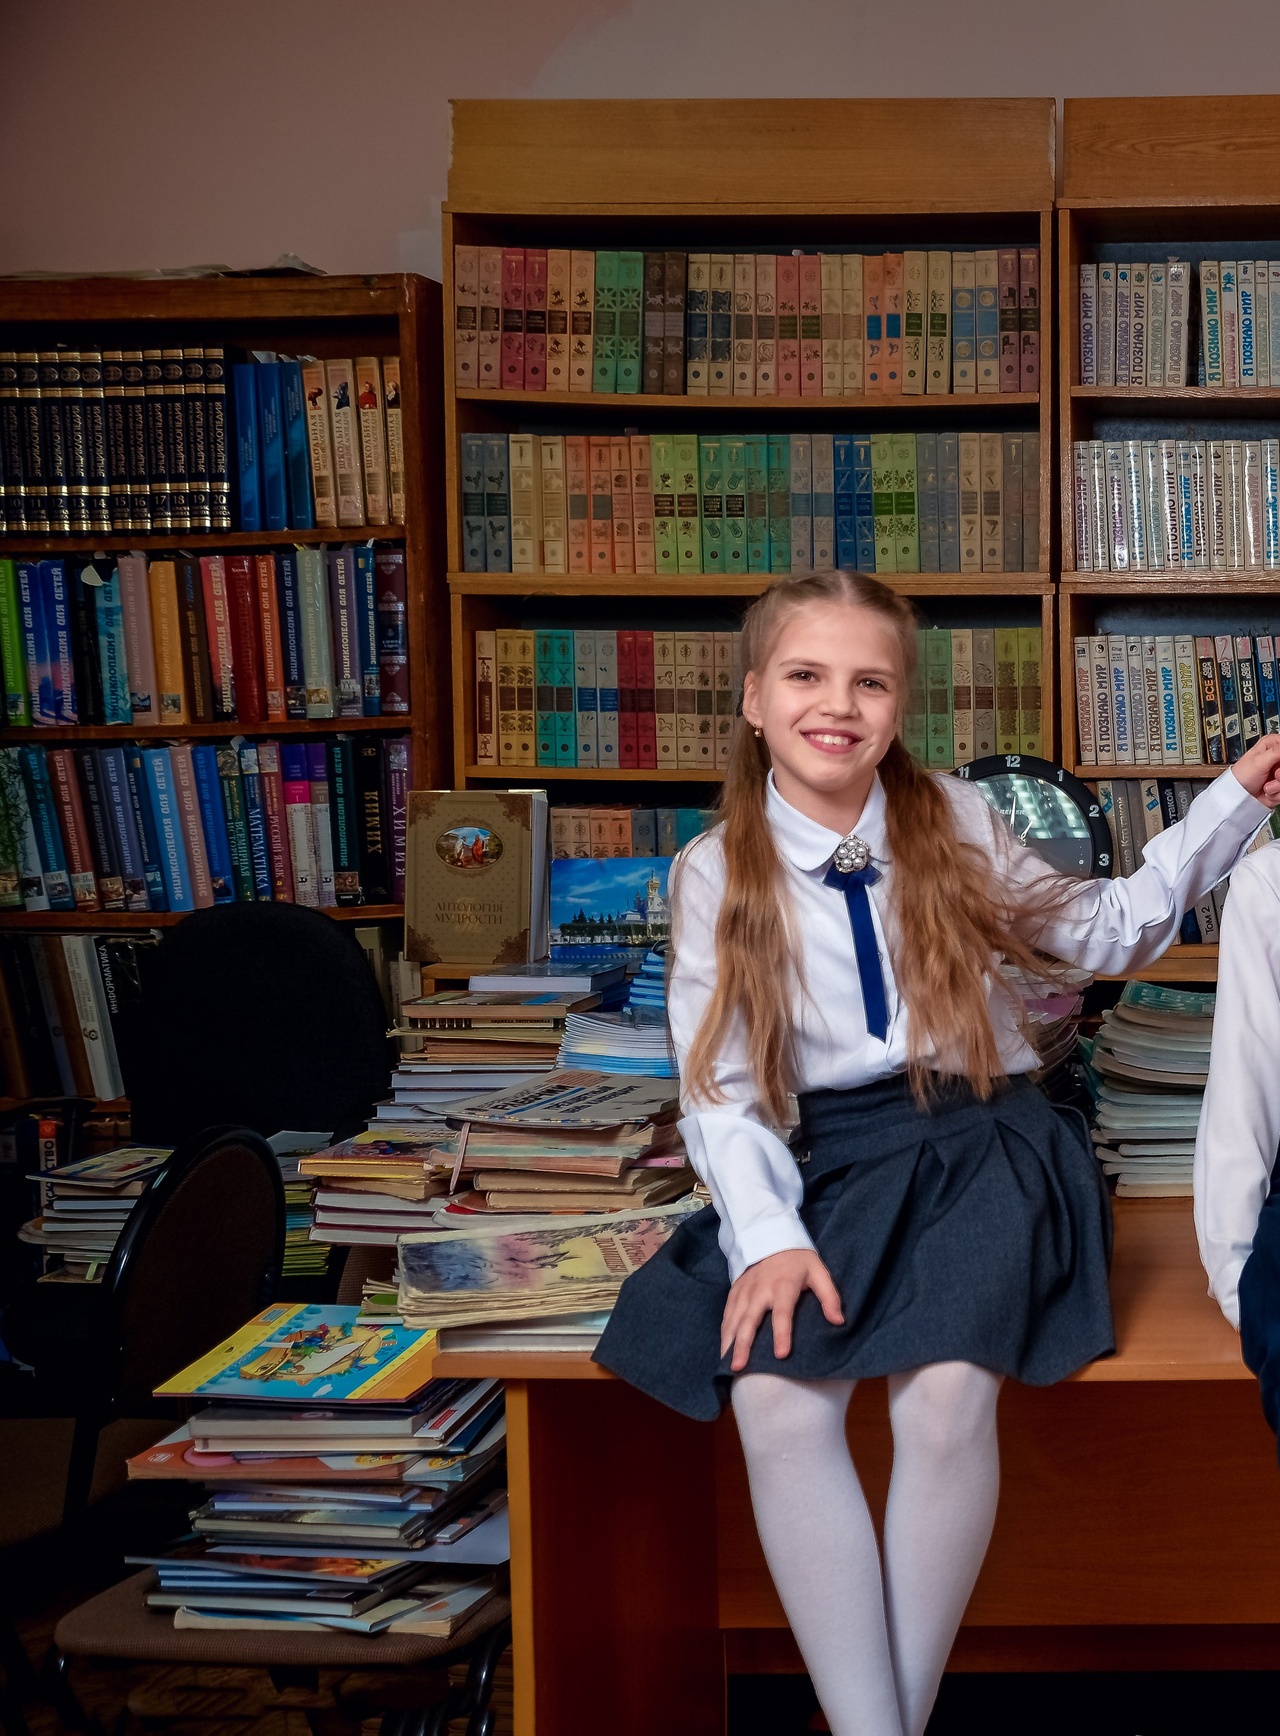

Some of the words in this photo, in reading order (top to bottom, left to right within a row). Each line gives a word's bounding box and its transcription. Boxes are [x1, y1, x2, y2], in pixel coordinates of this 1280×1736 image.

[1134, 292, 1144, 318] МИР
[1206, 288, 1218, 315] МИР
[1133, 323, 1144, 372] ПОЗНАЮ
[1207, 319, 1220, 369] ПОЗНАЮ
[1132, 376, 1142, 385] Я
[1208, 372, 1221, 381] Я
[310, 414, 320, 471] ШКОЛЬНАЯ
[334, 412, 345, 469] ШКОЛЬНАЯ
[362, 411, 373, 469] ШКОЛЬНАЯ
[73, 498, 85, 508] 13
[115, 497, 127, 506] 15
[135, 497, 146, 506] 16
[155, 495, 166, 505] 17
[173, 495, 185, 505] 18
[194, 495, 205, 504] 19
[213, 495, 226, 505] 20
[1221, 638, 1232, 660] 2
[1261, 637, 1271, 657] 4
[1078, 667, 1088, 691] МИР
[1096, 664, 1108, 690] МИР
[1161, 667, 1172, 691] МИР
[1180, 663, 1191, 688] МИР
[1204, 680, 1214, 701] ВСЕ
[1224, 680, 1234, 701] ВСЕ
[1242, 680, 1253, 702] ВСЕ
[1265, 680, 1275, 702] ВСЕ
[1079, 692, 1092, 740] ПОЗНАЮ
[1098, 692, 1109, 742] ПОЗНАЮ
[1164, 693, 1176, 740] ПОЗНАЮ
[1182, 692, 1196, 742] ПОЗНАЮ
[1082, 744, 1092, 752] Я
[1100, 745, 1110, 753] Я
[1166, 742, 1177, 750] Я
[1185, 745, 1197, 755] Я
[1005, 755, 1020, 767] 12
[959, 767, 970, 778] 11
[1057, 770, 1063, 781] 1
[1089, 805, 1099, 817] 2
[1116, 796, 1130, 826] такой
[1164, 788, 1177, 818] такой
[270, 815, 281, 852] РУССКИЙ
[363, 790, 382, 855] ХИМИЯ
[226, 822, 238, 866] ИСТОРИЯ
[392, 806, 406, 876] ХИМИЯ
[1120, 828, 1133, 846] Кто
[234, 821, 245, 876] ВСЕМИРНАЯ
[248, 808, 268, 889] МАТЕМАТИКА
[273, 853, 284, 878] ЯЗЫК
[1099, 854, 1109, 866] 3
[435, 902, 503, 912] АНТОЛОГИЯ
[435, 913, 502, 924] МУДРОСТИ
[1204, 915, 1214, 934] Том
[98, 944, 118, 1014] ИНФОРМАТИКА
